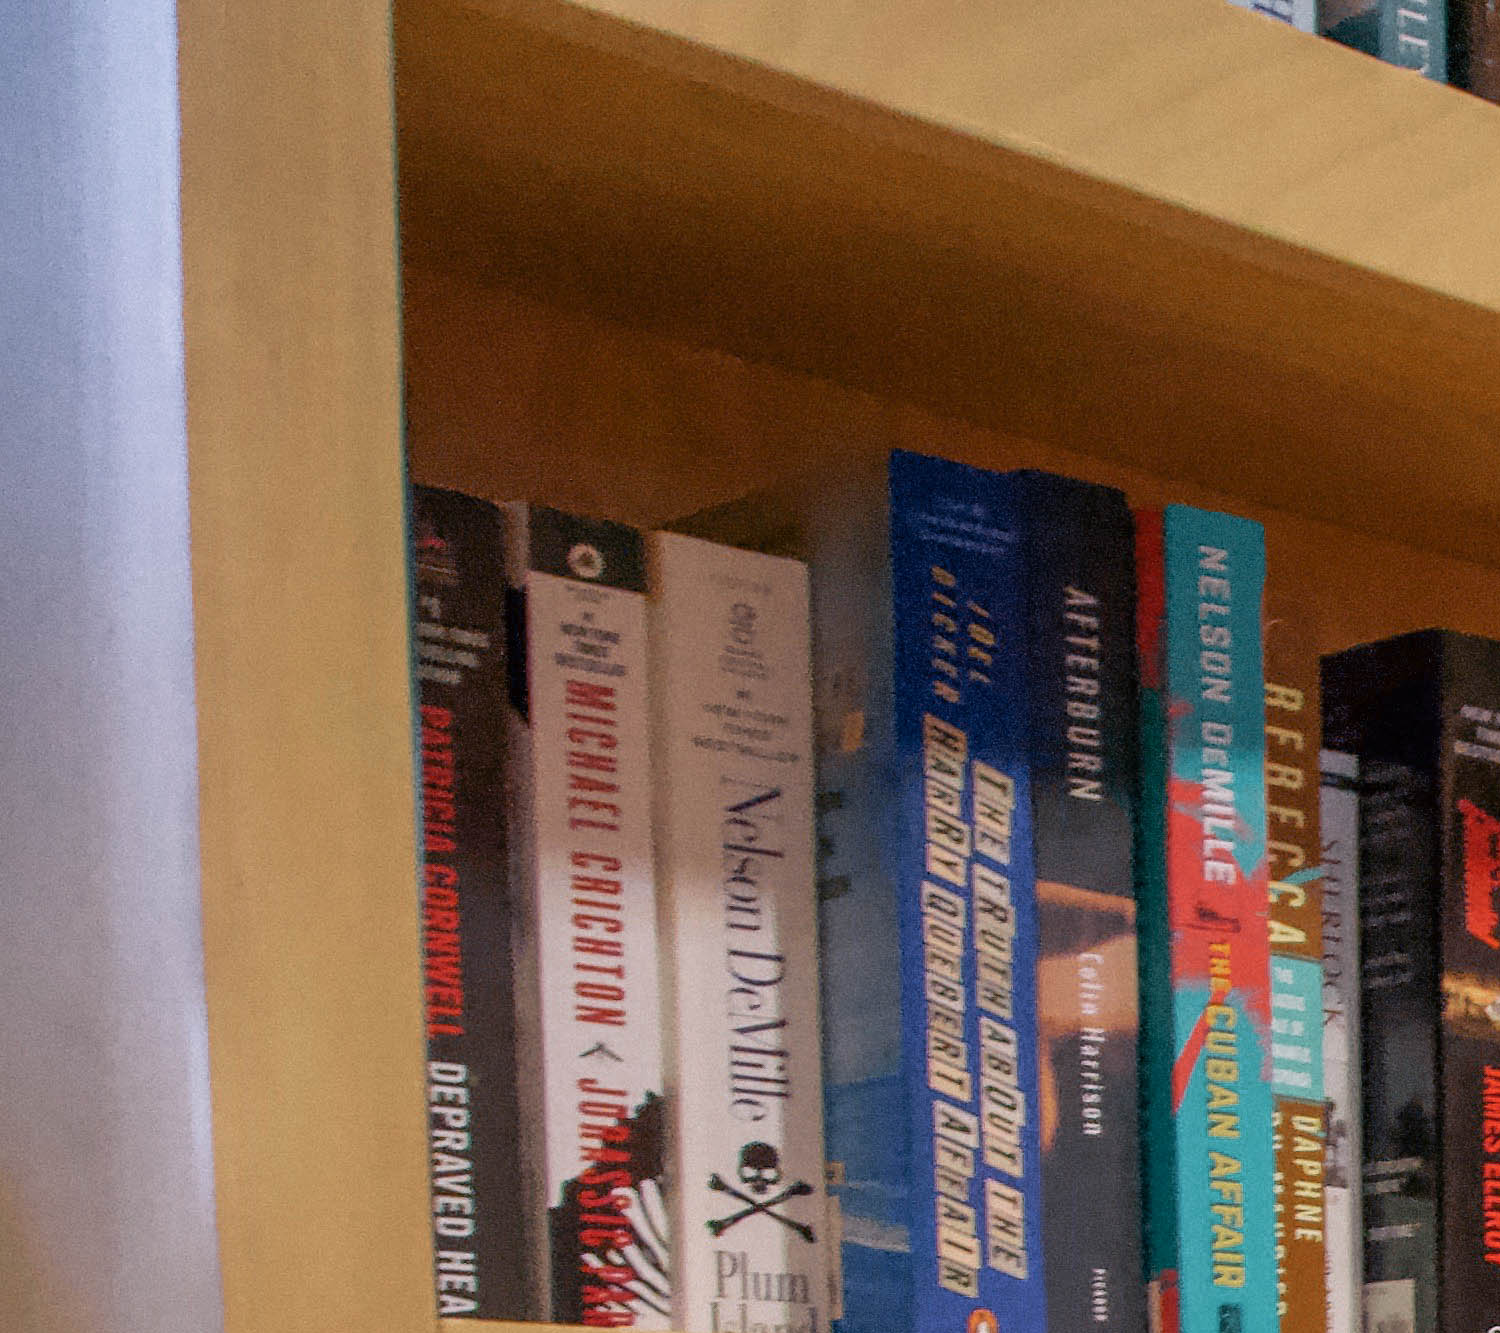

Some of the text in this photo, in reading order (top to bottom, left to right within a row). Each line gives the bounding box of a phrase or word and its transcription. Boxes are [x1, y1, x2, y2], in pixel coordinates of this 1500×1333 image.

[1061, 582, 1103, 803] AFTERBURN
[1196, 543, 1232, 703] NELSON
[421, 703, 472, 1240] PATRICIA CORNWELL DEPRAVED
[564, 678, 628, 1028] MICHAEL CRICHTON
[724, 776, 792, 1126] Nelson DeMille
[1203, 942, 1232, 1003] THE
[921, 714, 980, 1297] HARRY QUEBERT AFFAIR
[971, 759, 1028, 1278] THE TRUTH ABOUT THE
[1205, 1004, 1242, 1139] CUBAN
[1208, 1150, 1247, 1289] AFFAIR
